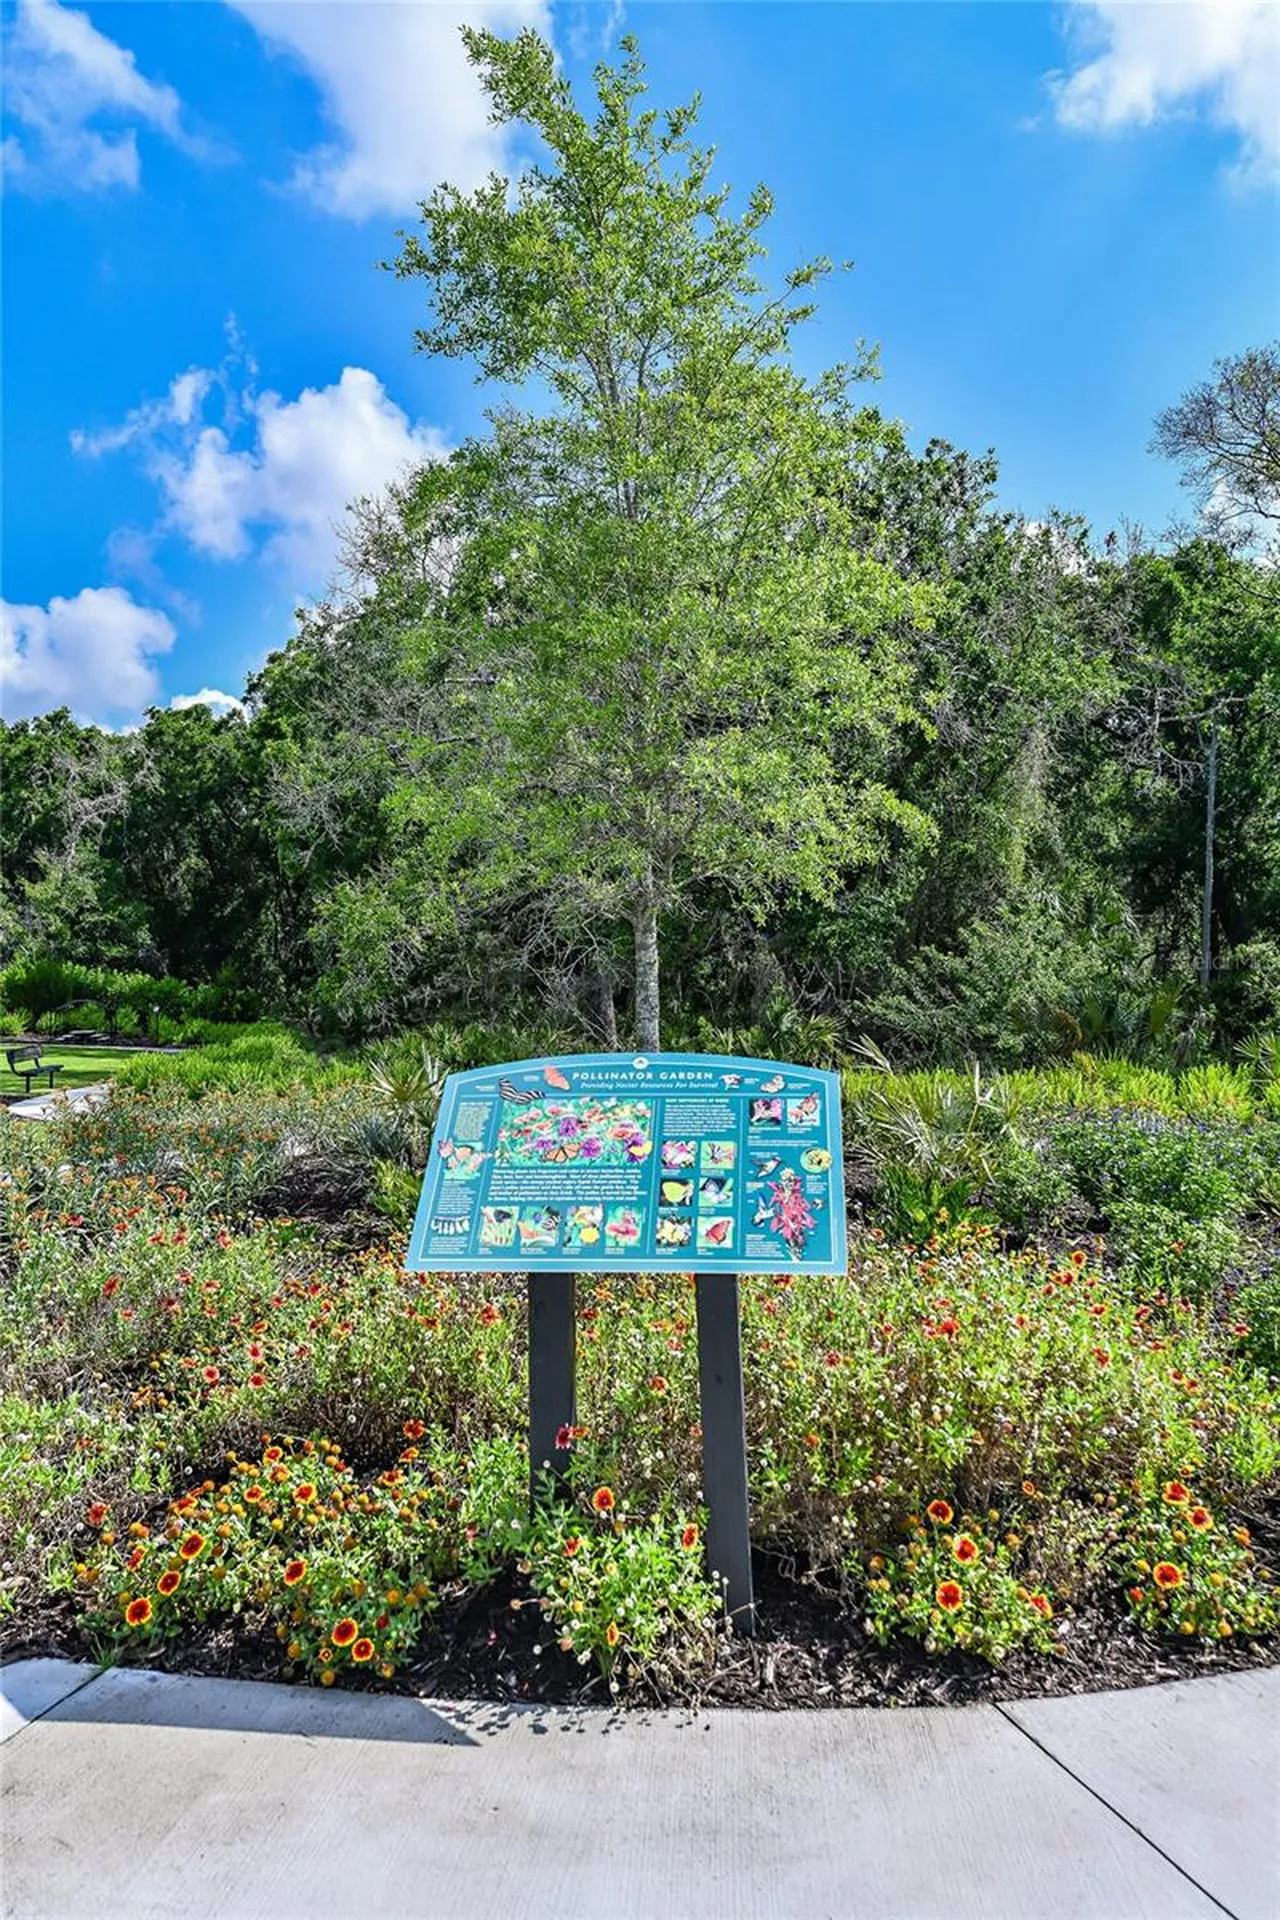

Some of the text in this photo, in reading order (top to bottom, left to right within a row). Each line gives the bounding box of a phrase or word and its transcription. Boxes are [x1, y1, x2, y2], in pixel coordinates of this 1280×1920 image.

[572, 1071, 713, 1081] POLLINATOR GARDEN
[580, 1082, 614, 1090] Providing
